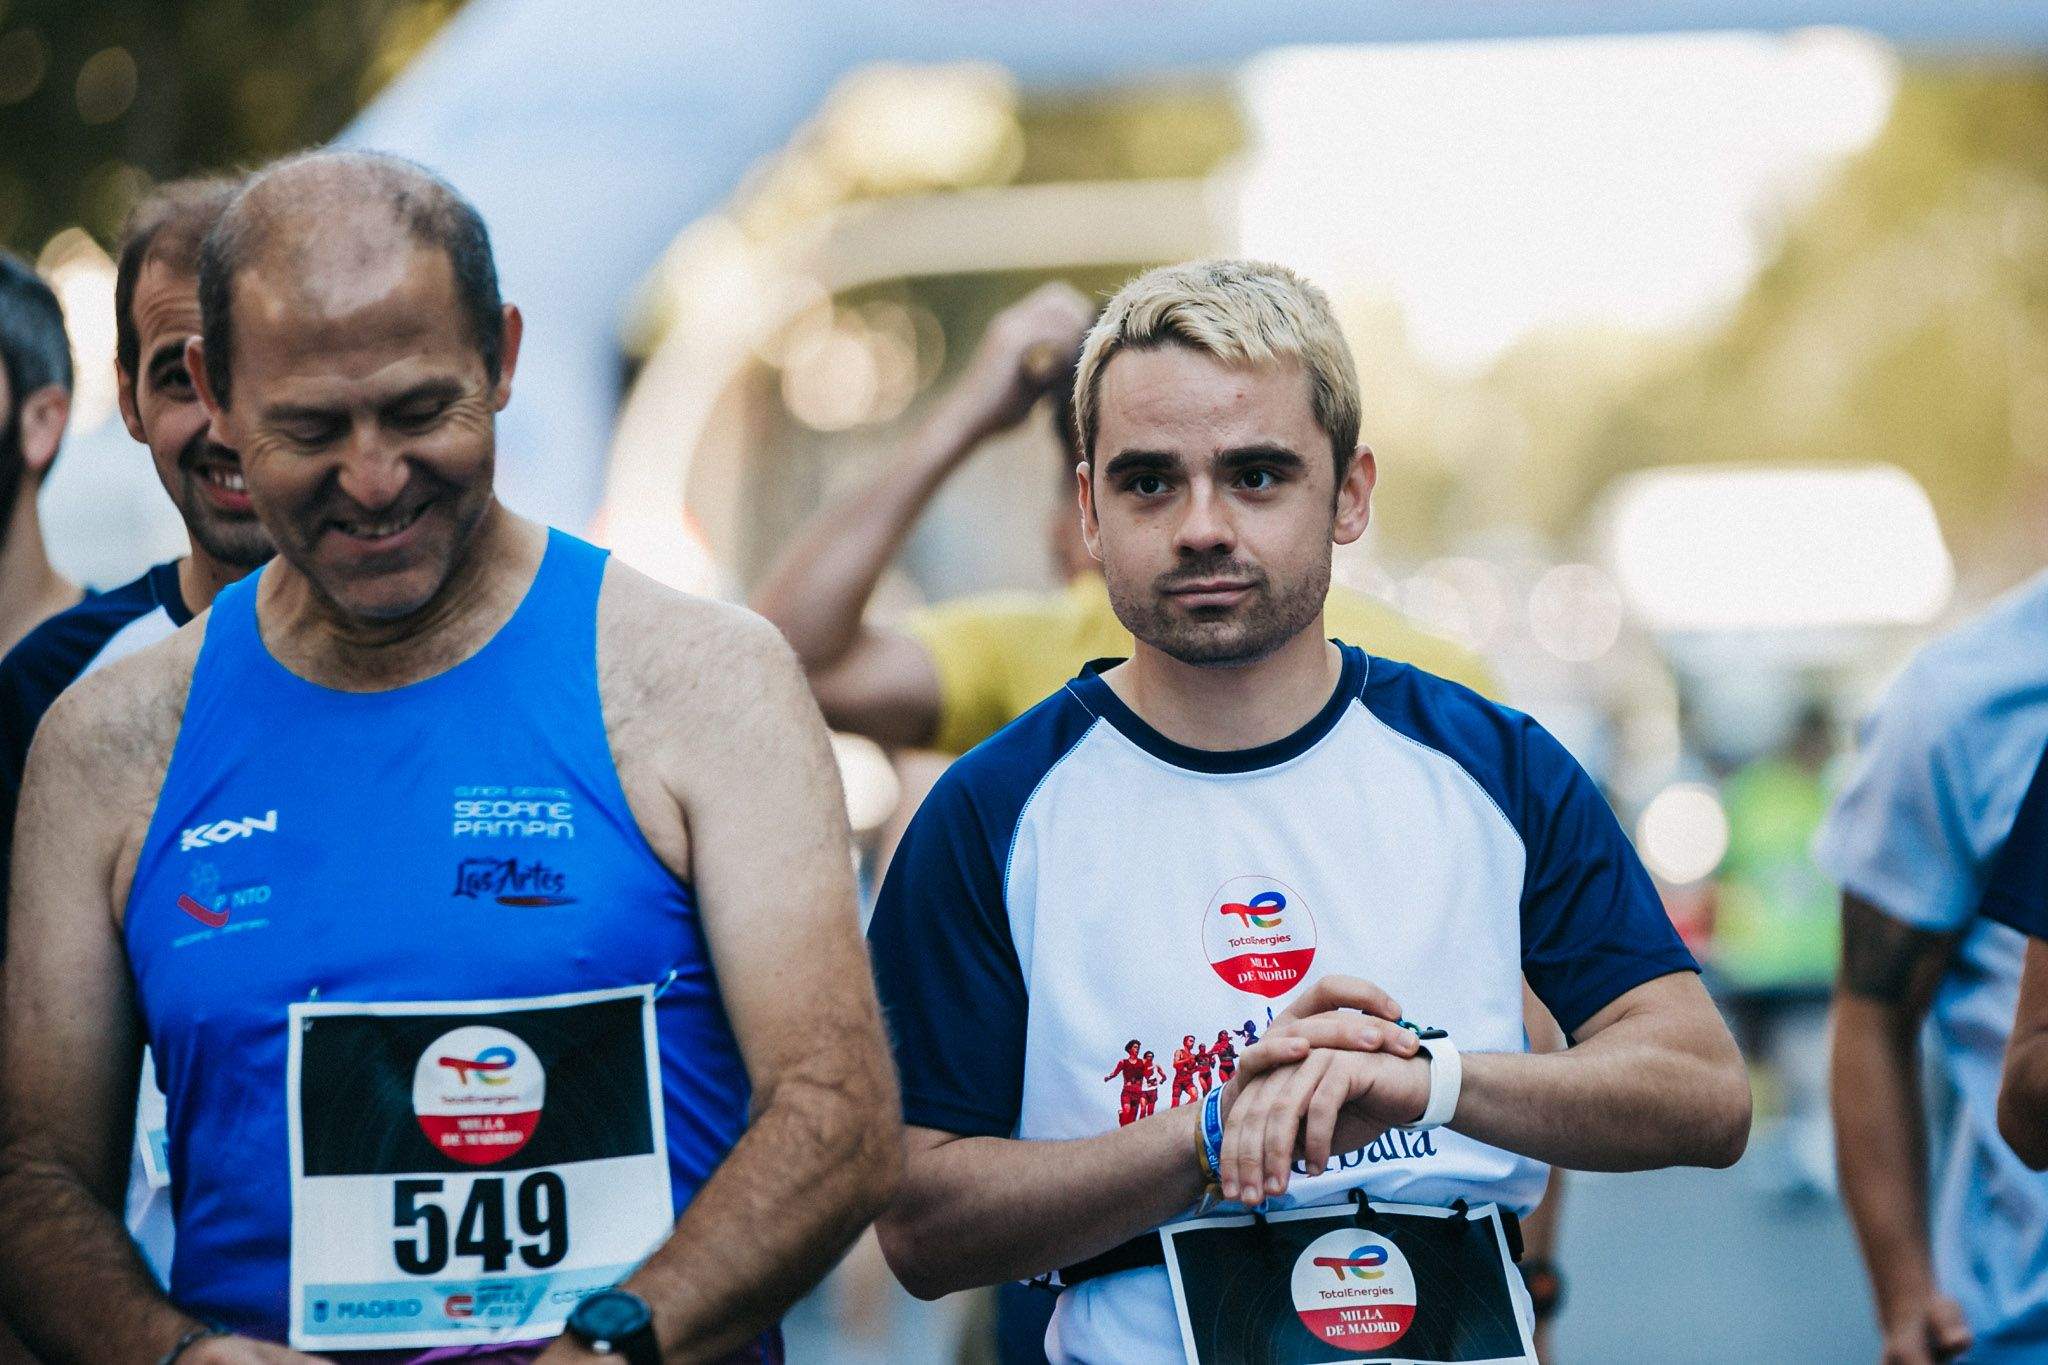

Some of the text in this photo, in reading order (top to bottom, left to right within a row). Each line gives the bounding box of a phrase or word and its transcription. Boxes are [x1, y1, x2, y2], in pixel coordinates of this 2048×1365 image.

[454, 801, 573, 820] SEOANE
[454, 821, 575, 838] PAMPIN
[1238, 971, 1257, 984] DE
[393, 1171, 569, 1276] 549
[1319, 1286, 1394, 1300] TotalEnergies
[337, 1299, 422, 1319] MADRID
[1340, 1309, 1383, 1322] MILLA
[1325, 1322, 1400, 1337] DE MADRID
